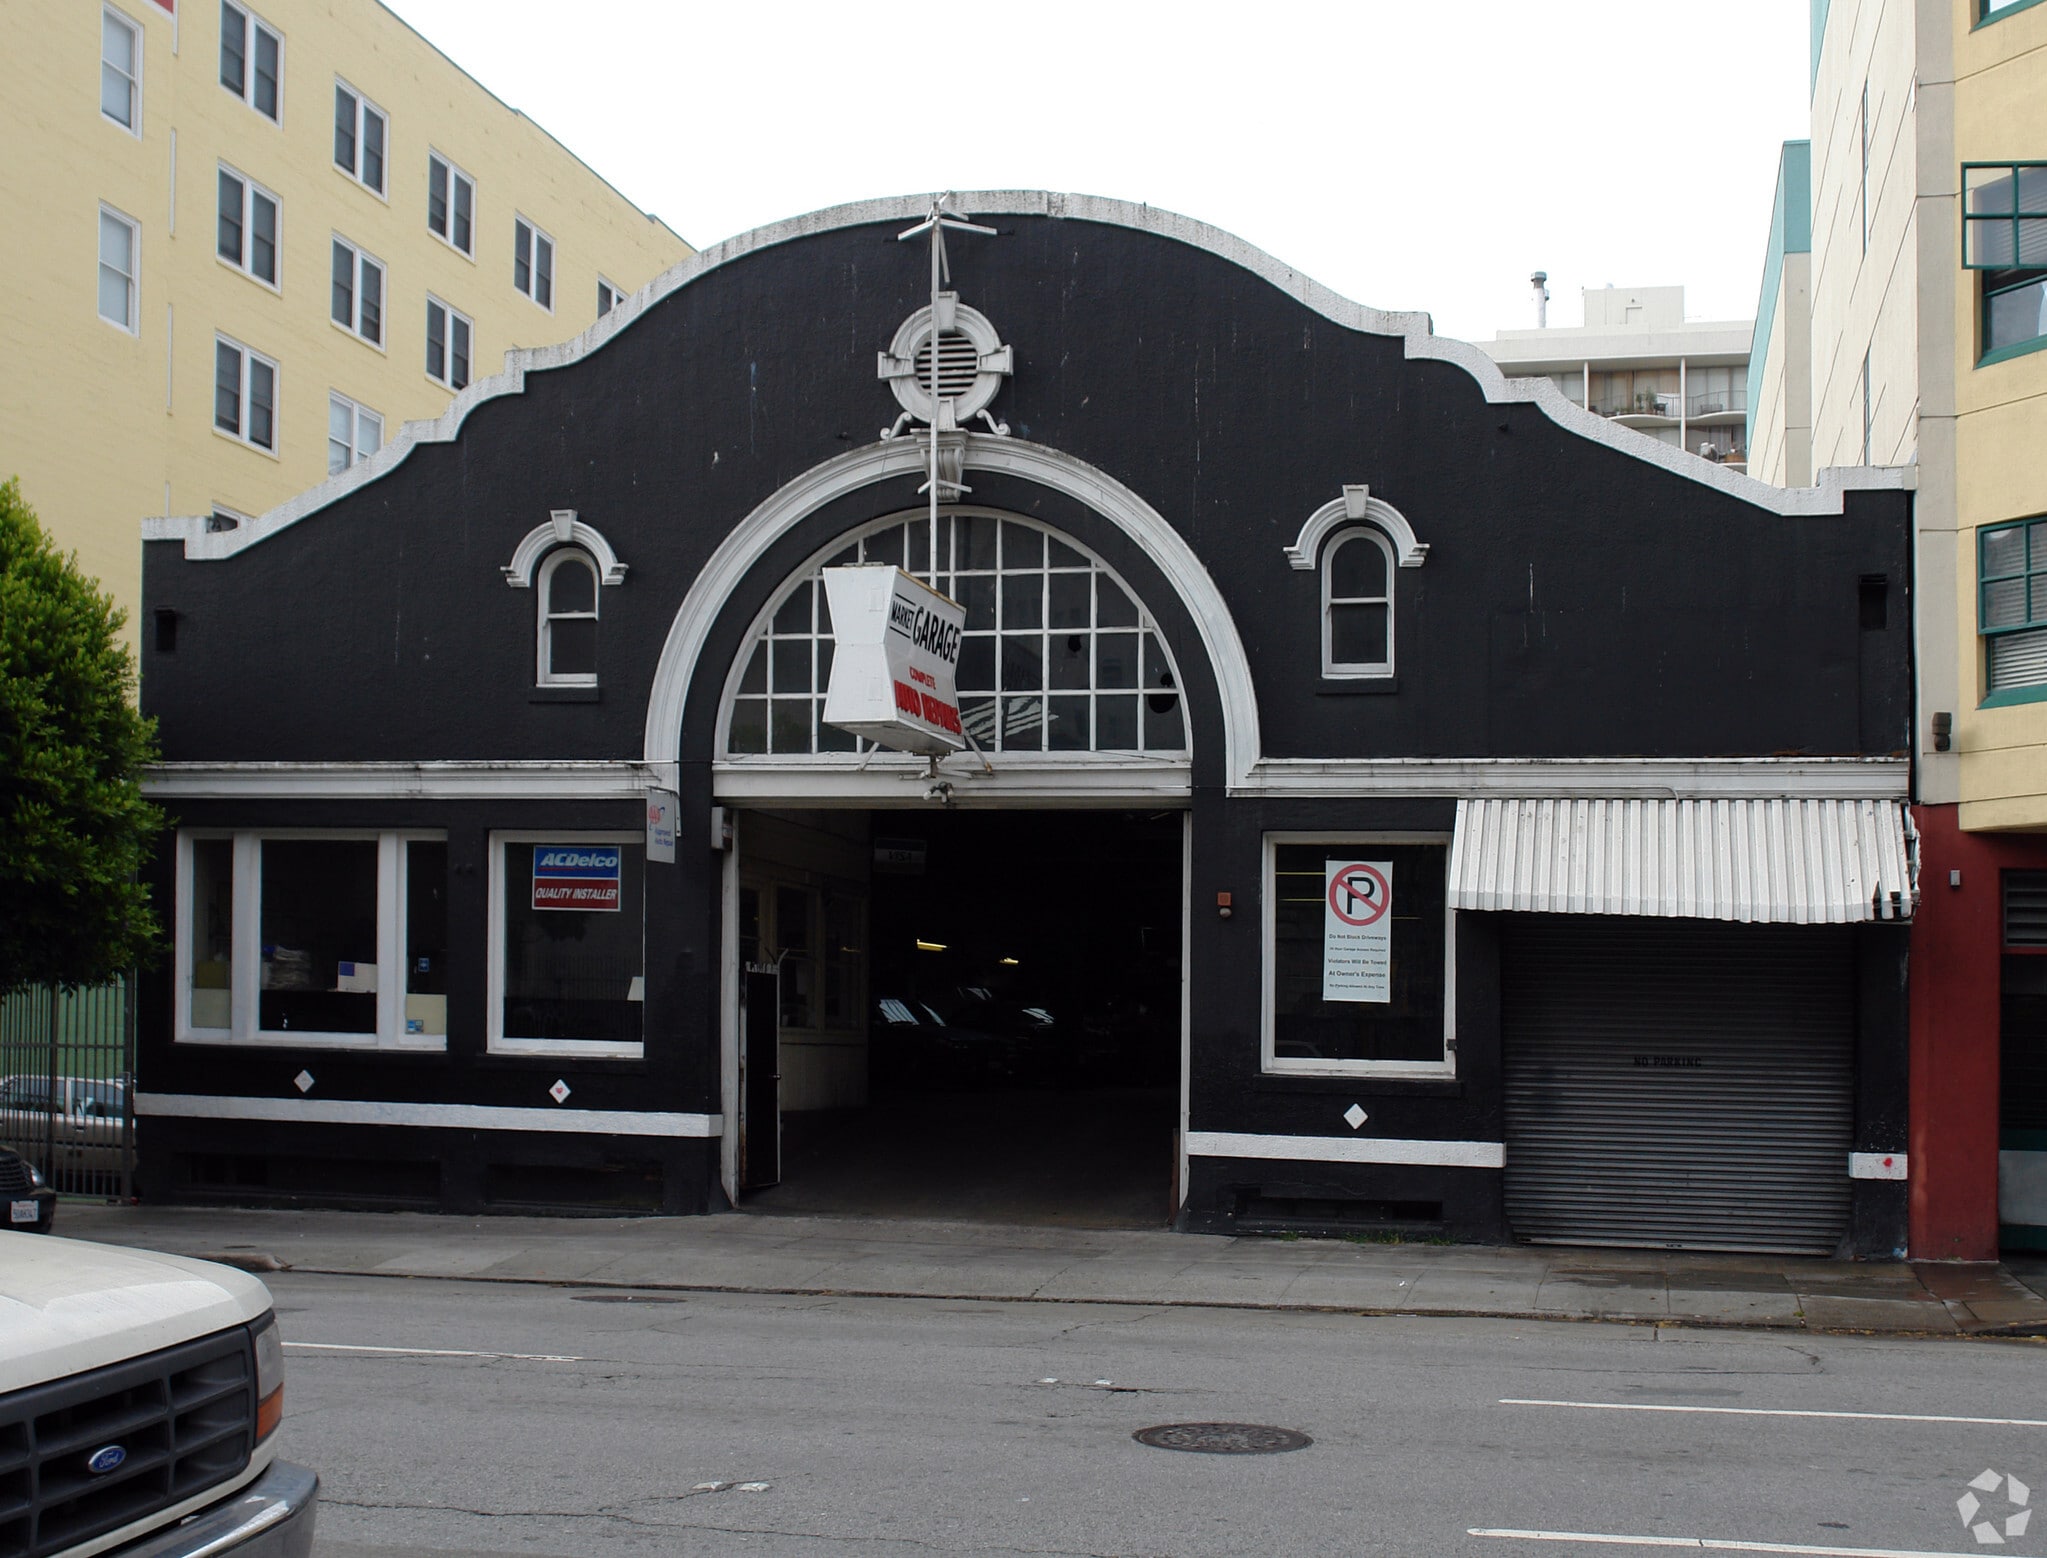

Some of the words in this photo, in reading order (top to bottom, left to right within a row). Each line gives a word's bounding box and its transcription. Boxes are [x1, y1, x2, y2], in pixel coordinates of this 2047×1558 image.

[891, 601, 914, 631] MARKET
[913, 606, 960, 664] GARAGE
[540, 853, 617, 867] ACDelco
[535, 887, 572, 899] QUALITY
[572, 888, 617, 900] INSTALLER
[1633, 1056, 1649, 1067] NO
[1654, 1056, 1702, 1068] PARKING
[98, 1451, 119, 1468] Ford
